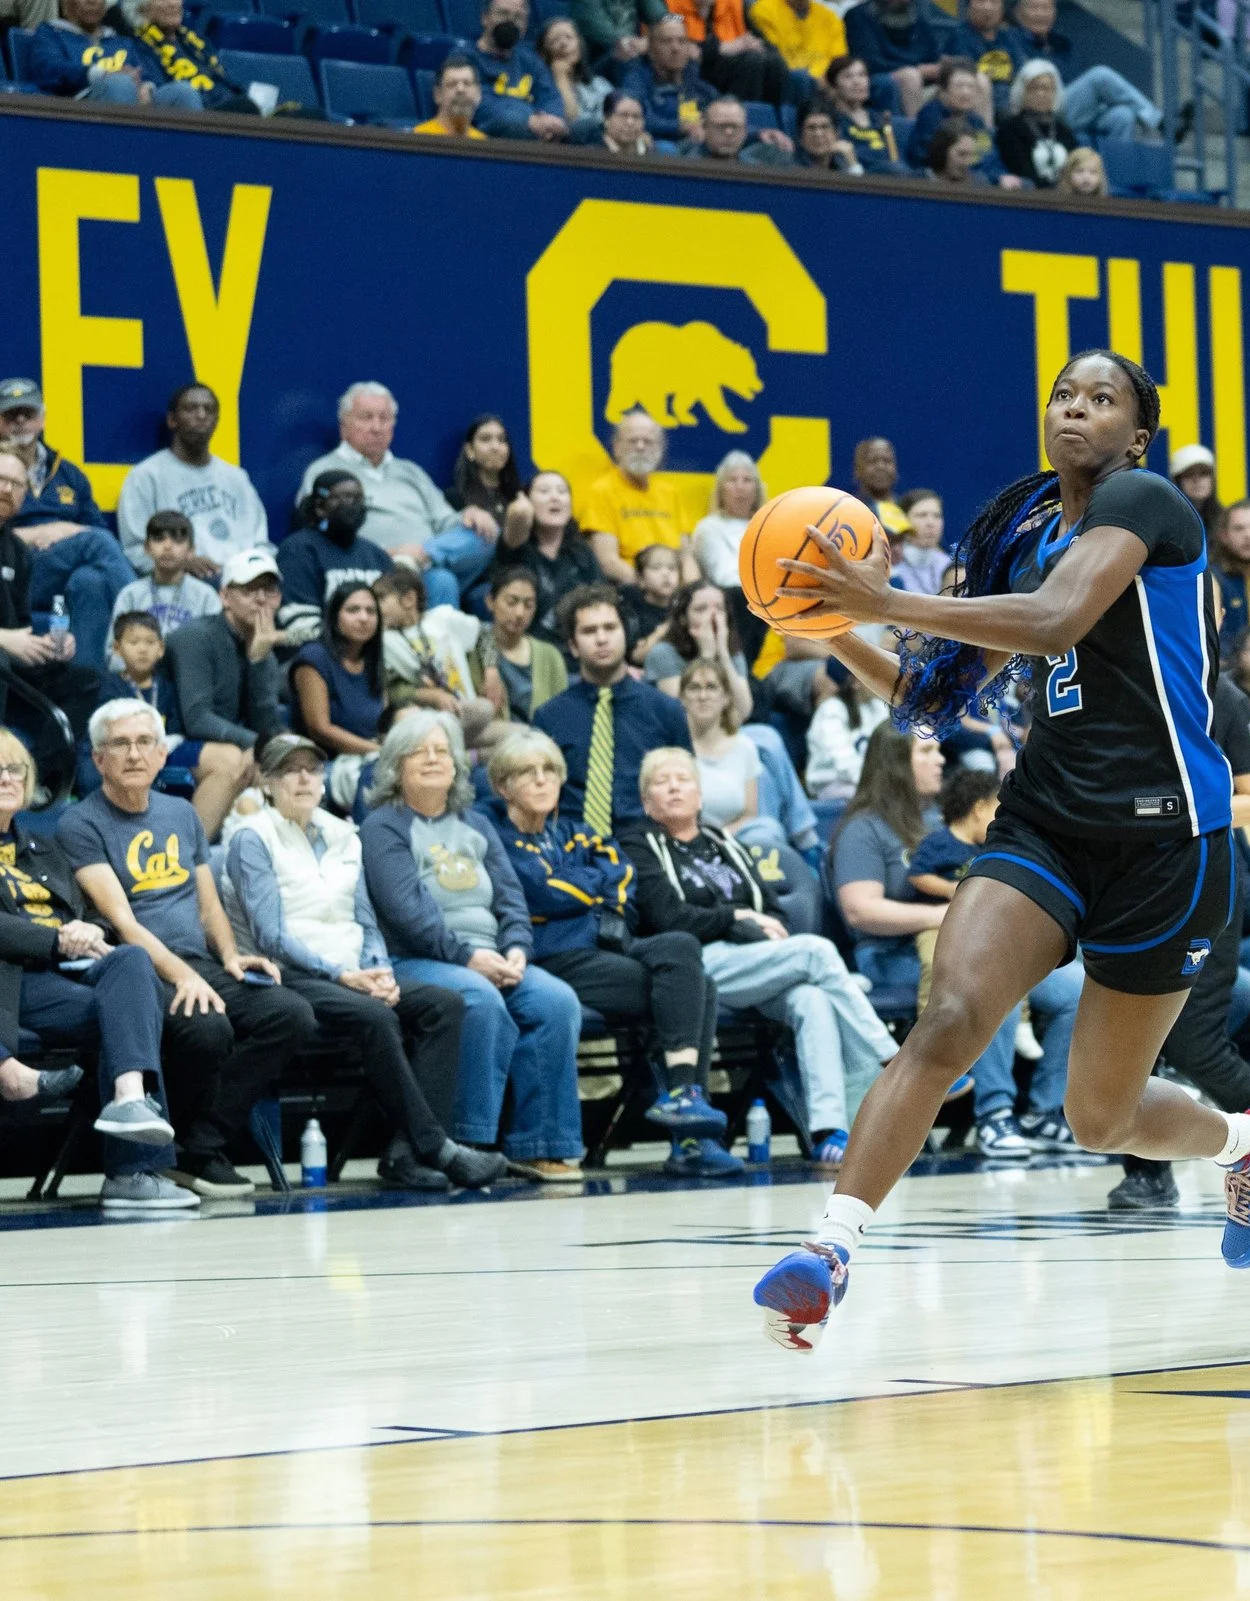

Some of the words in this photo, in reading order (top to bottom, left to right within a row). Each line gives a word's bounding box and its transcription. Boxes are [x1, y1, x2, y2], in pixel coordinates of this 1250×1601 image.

[1045, 646, 1082, 717] 2
[1166, 801, 1174, 811] S
[126, 830, 190, 893] Cal
